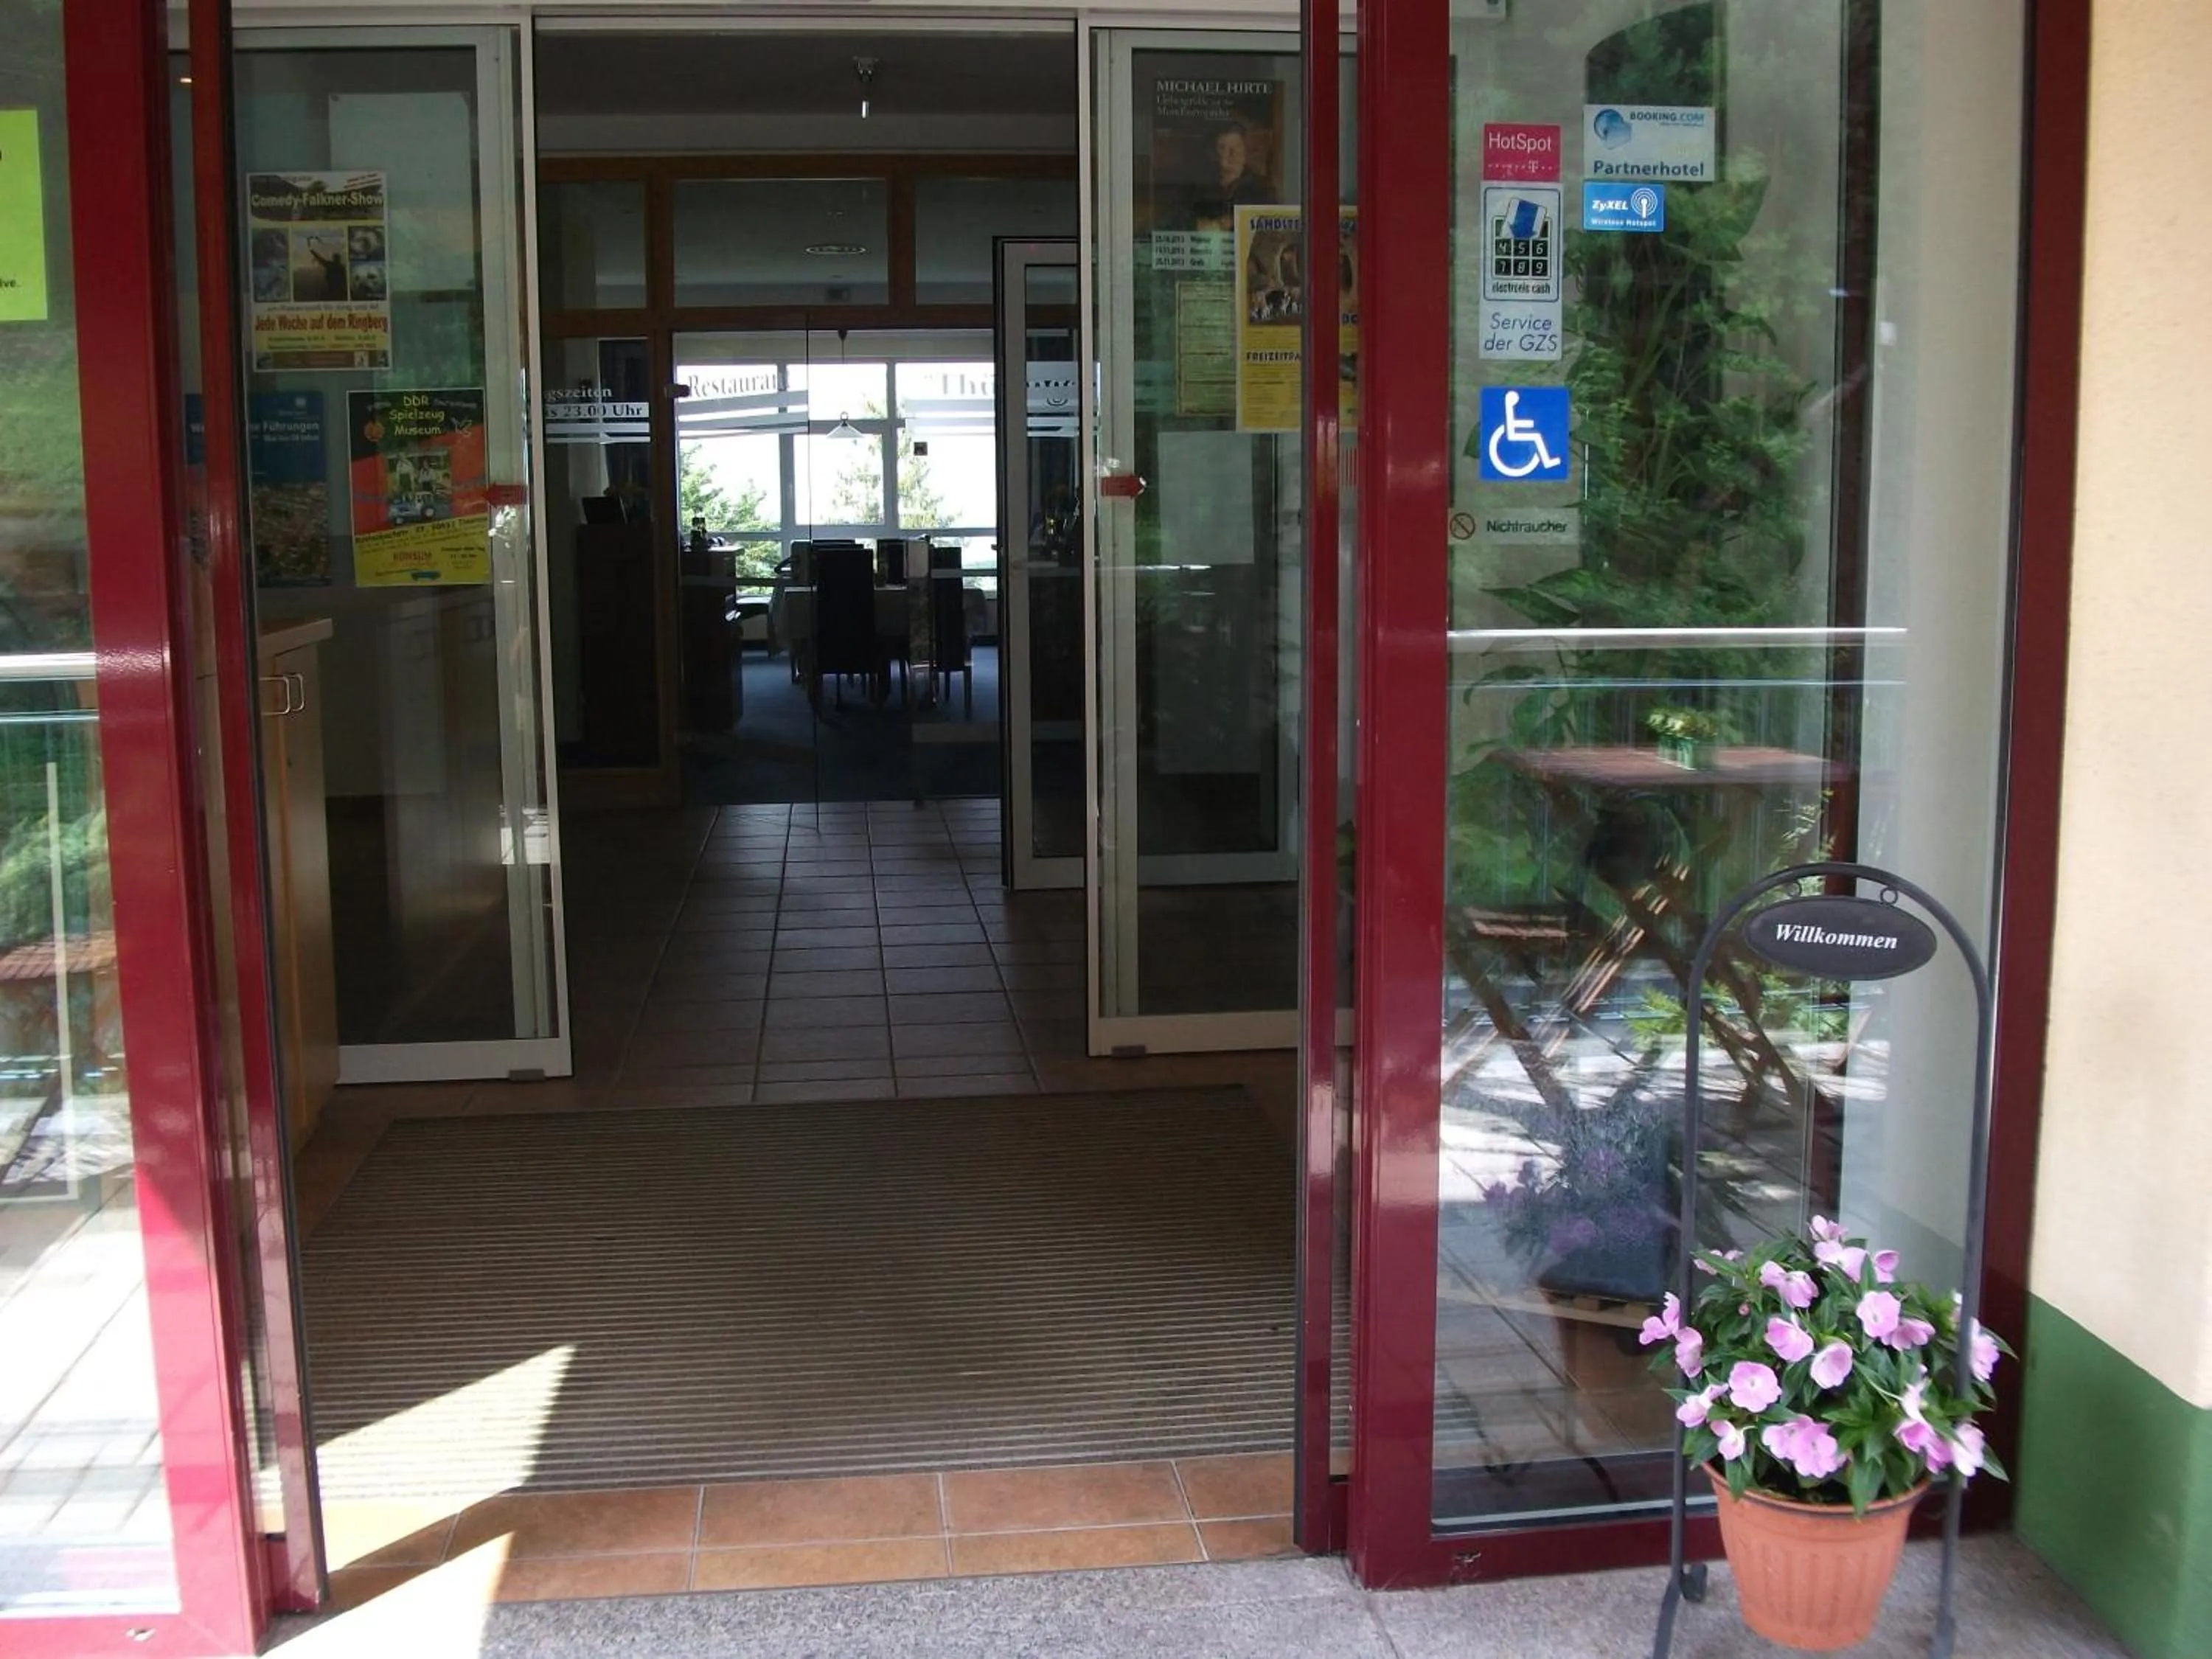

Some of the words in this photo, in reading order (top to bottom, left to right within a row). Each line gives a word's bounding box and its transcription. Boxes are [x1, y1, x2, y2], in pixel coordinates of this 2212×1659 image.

[1157, 80, 1222, 93] MICHAEL
[1629, 111, 1705, 122] BOOKING.COM
[1488, 131, 1552, 153] HotSpot
[1593, 160, 1704, 177] Partnerhotel
[1592, 200, 1629, 212] ZyXEL
[1535, 242, 1544, 255] 6
[1535, 262, 1545, 275] 9
[1532, 283, 1551, 294] cash
[310, 313, 324, 330] auf
[327, 313, 347, 330] dem
[1489, 311, 1552, 331] Service
[1484, 332, 1513, 352] der
[1519, 334, 1558, 352] GZS
[403, 394, 430, 407] DDR
[389, 408, 446, 423] Spielzeug
[613, 403, 644, 417] Uhr
[394, 425, 442, 437] Museum
[1486, 520, 1567, 533] Nichtraucher
[1775, 924, 1898, 950] Willkommen
